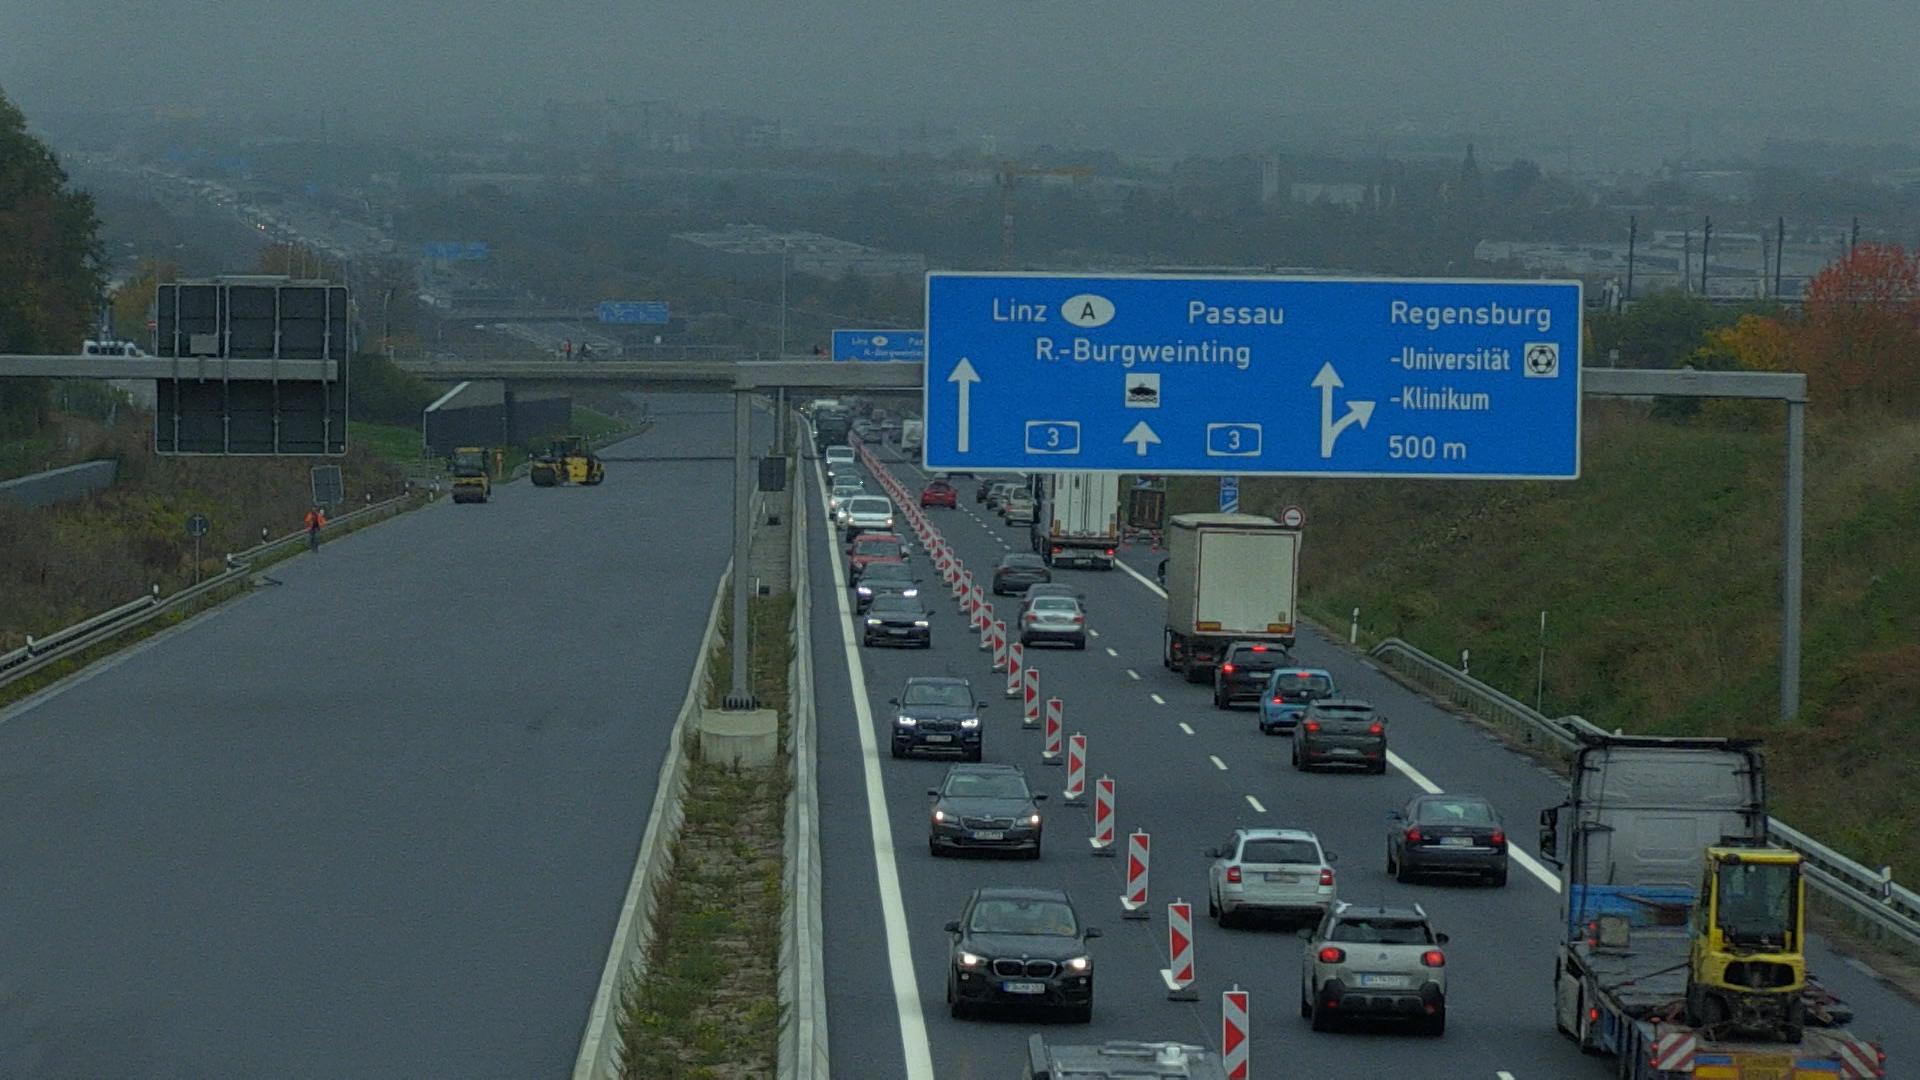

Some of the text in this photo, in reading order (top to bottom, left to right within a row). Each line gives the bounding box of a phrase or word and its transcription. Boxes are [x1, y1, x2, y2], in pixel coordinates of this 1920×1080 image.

[993, 299, 1097, 322] Linz A
[1189, 300, 1284, 325] Passau
[1391, 300, 1551, 332] Regensburg
[1036, 338, 1250, 370] R.-Burgweinting
[1391, 346, 1510, 371] -Universität
[1391, 386, 1489, 410] -Klinikum
[1047, 427, 1060, 447] 3
[1229, 430, 1241, 450] 3
[1389, 435, 1466, 459] 500 m
